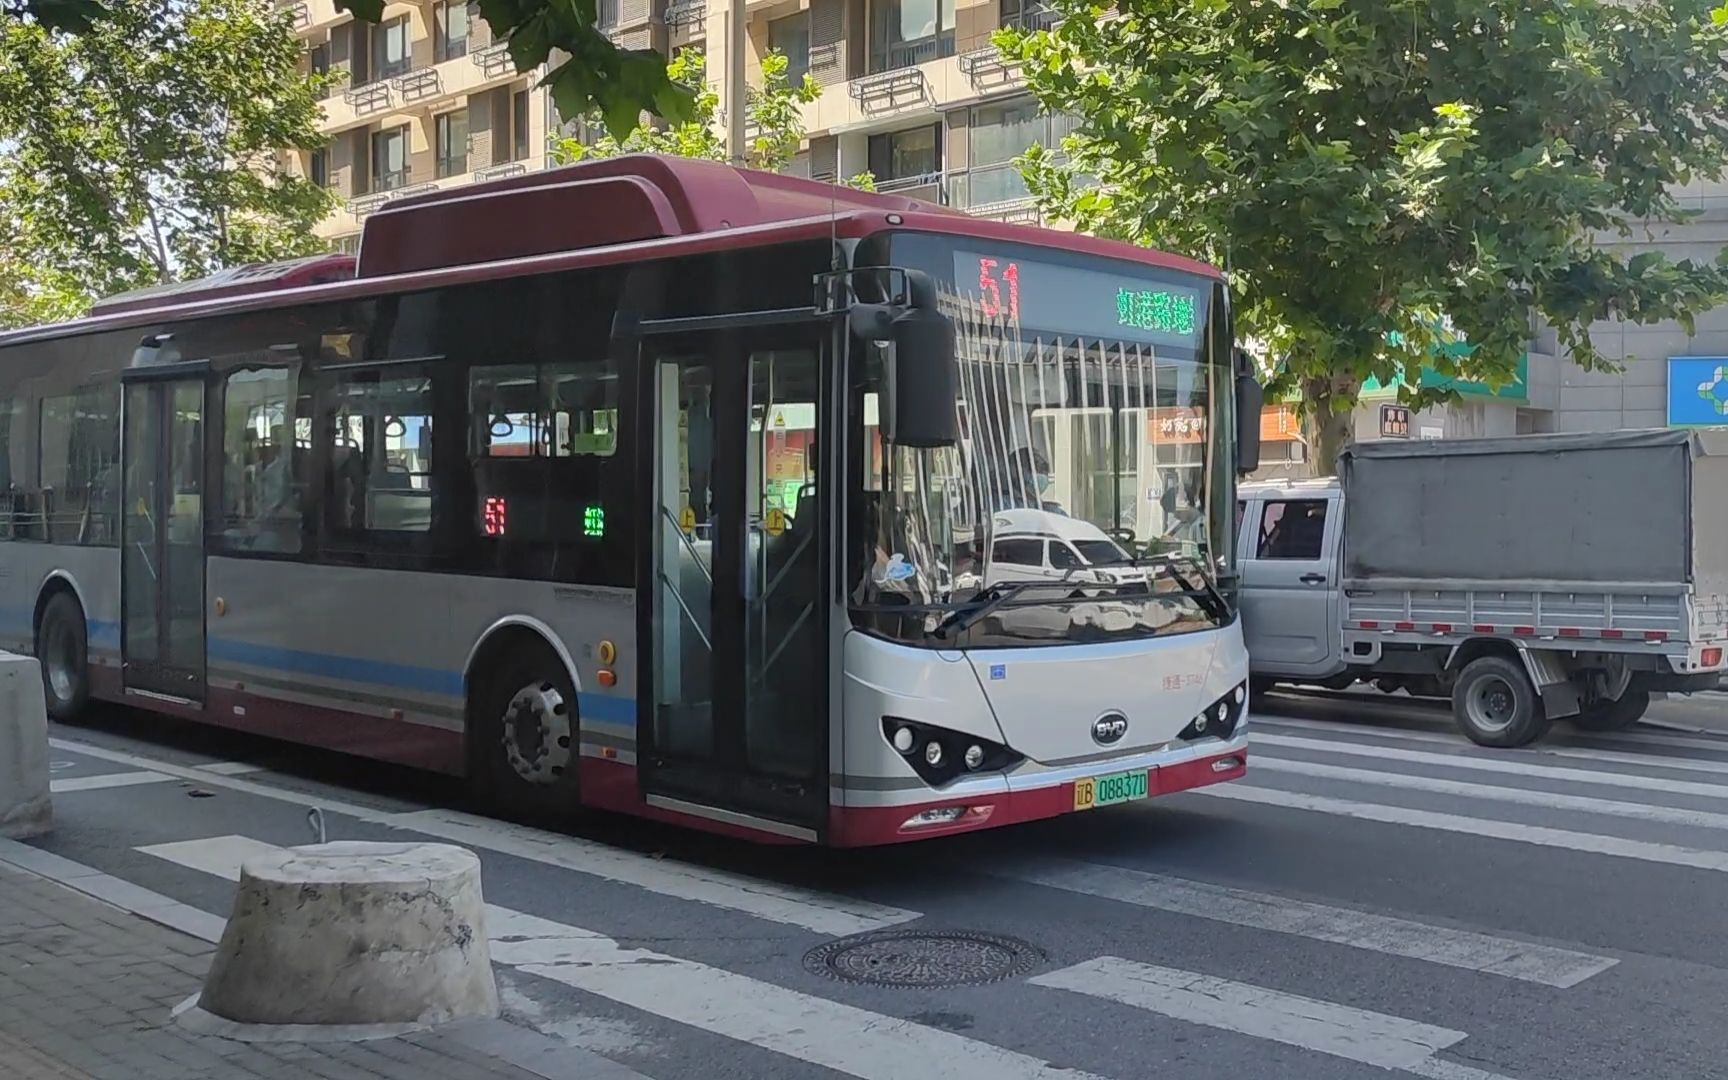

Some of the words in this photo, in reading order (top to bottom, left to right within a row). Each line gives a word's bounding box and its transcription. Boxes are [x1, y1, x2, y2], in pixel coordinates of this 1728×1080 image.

[980, 259, 1018, 320] 51
[486, 498, 504, 534] 51
[767, 509, 783, 531] 上
[1097, 721, 1125, 737] BYD
[1099, 774, 1147, 801] 08837D
